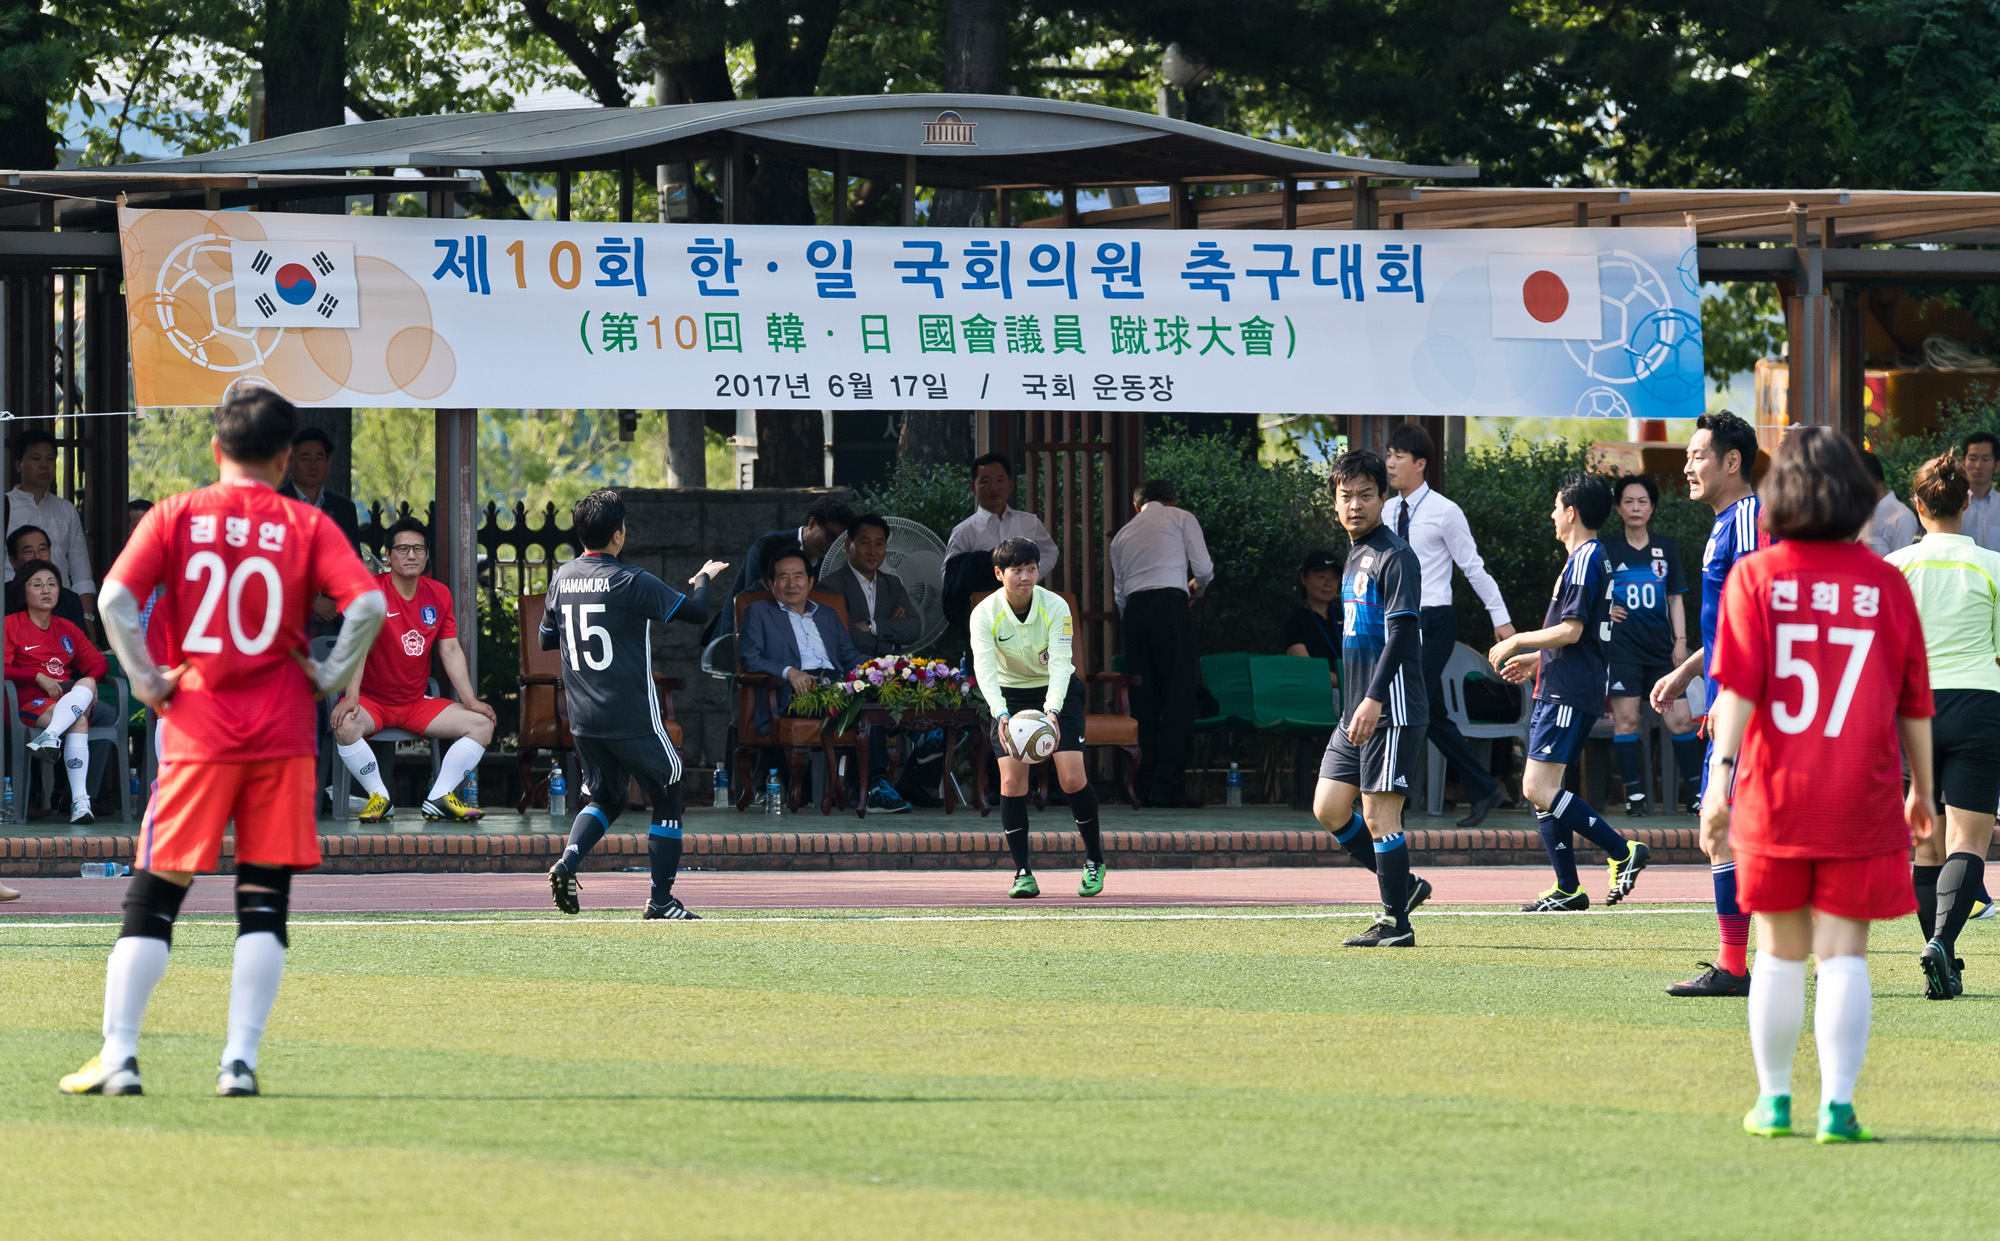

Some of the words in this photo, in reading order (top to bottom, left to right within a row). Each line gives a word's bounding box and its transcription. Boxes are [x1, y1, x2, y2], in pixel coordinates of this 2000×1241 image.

[433, 235, 647, 296] 제10회
[894, 240, 1144, 299] 국회의원
[1181, 241, 1425, 303] 축구대회
[580, 310, 742, 355] (第10回
[918, 313, 1086, 355] 國會議員
[715, 373, 810, 399] 2017년
[828, 373, 874, 400] 6월
[890, 374, 948, 400] 17일
[980, 374, 990, 399] /
[1022, 374, 1076, 400] 국회
[1093, 374, 1174, 401] 운동장
[182, 553, 283, 655] 20
[560, 577, 610, 594] HAMAMURA
[1626, 583, 1656, 610] 80
[560, 603, 614, 671] 15
[1772, 623, 1876, 737] 57
